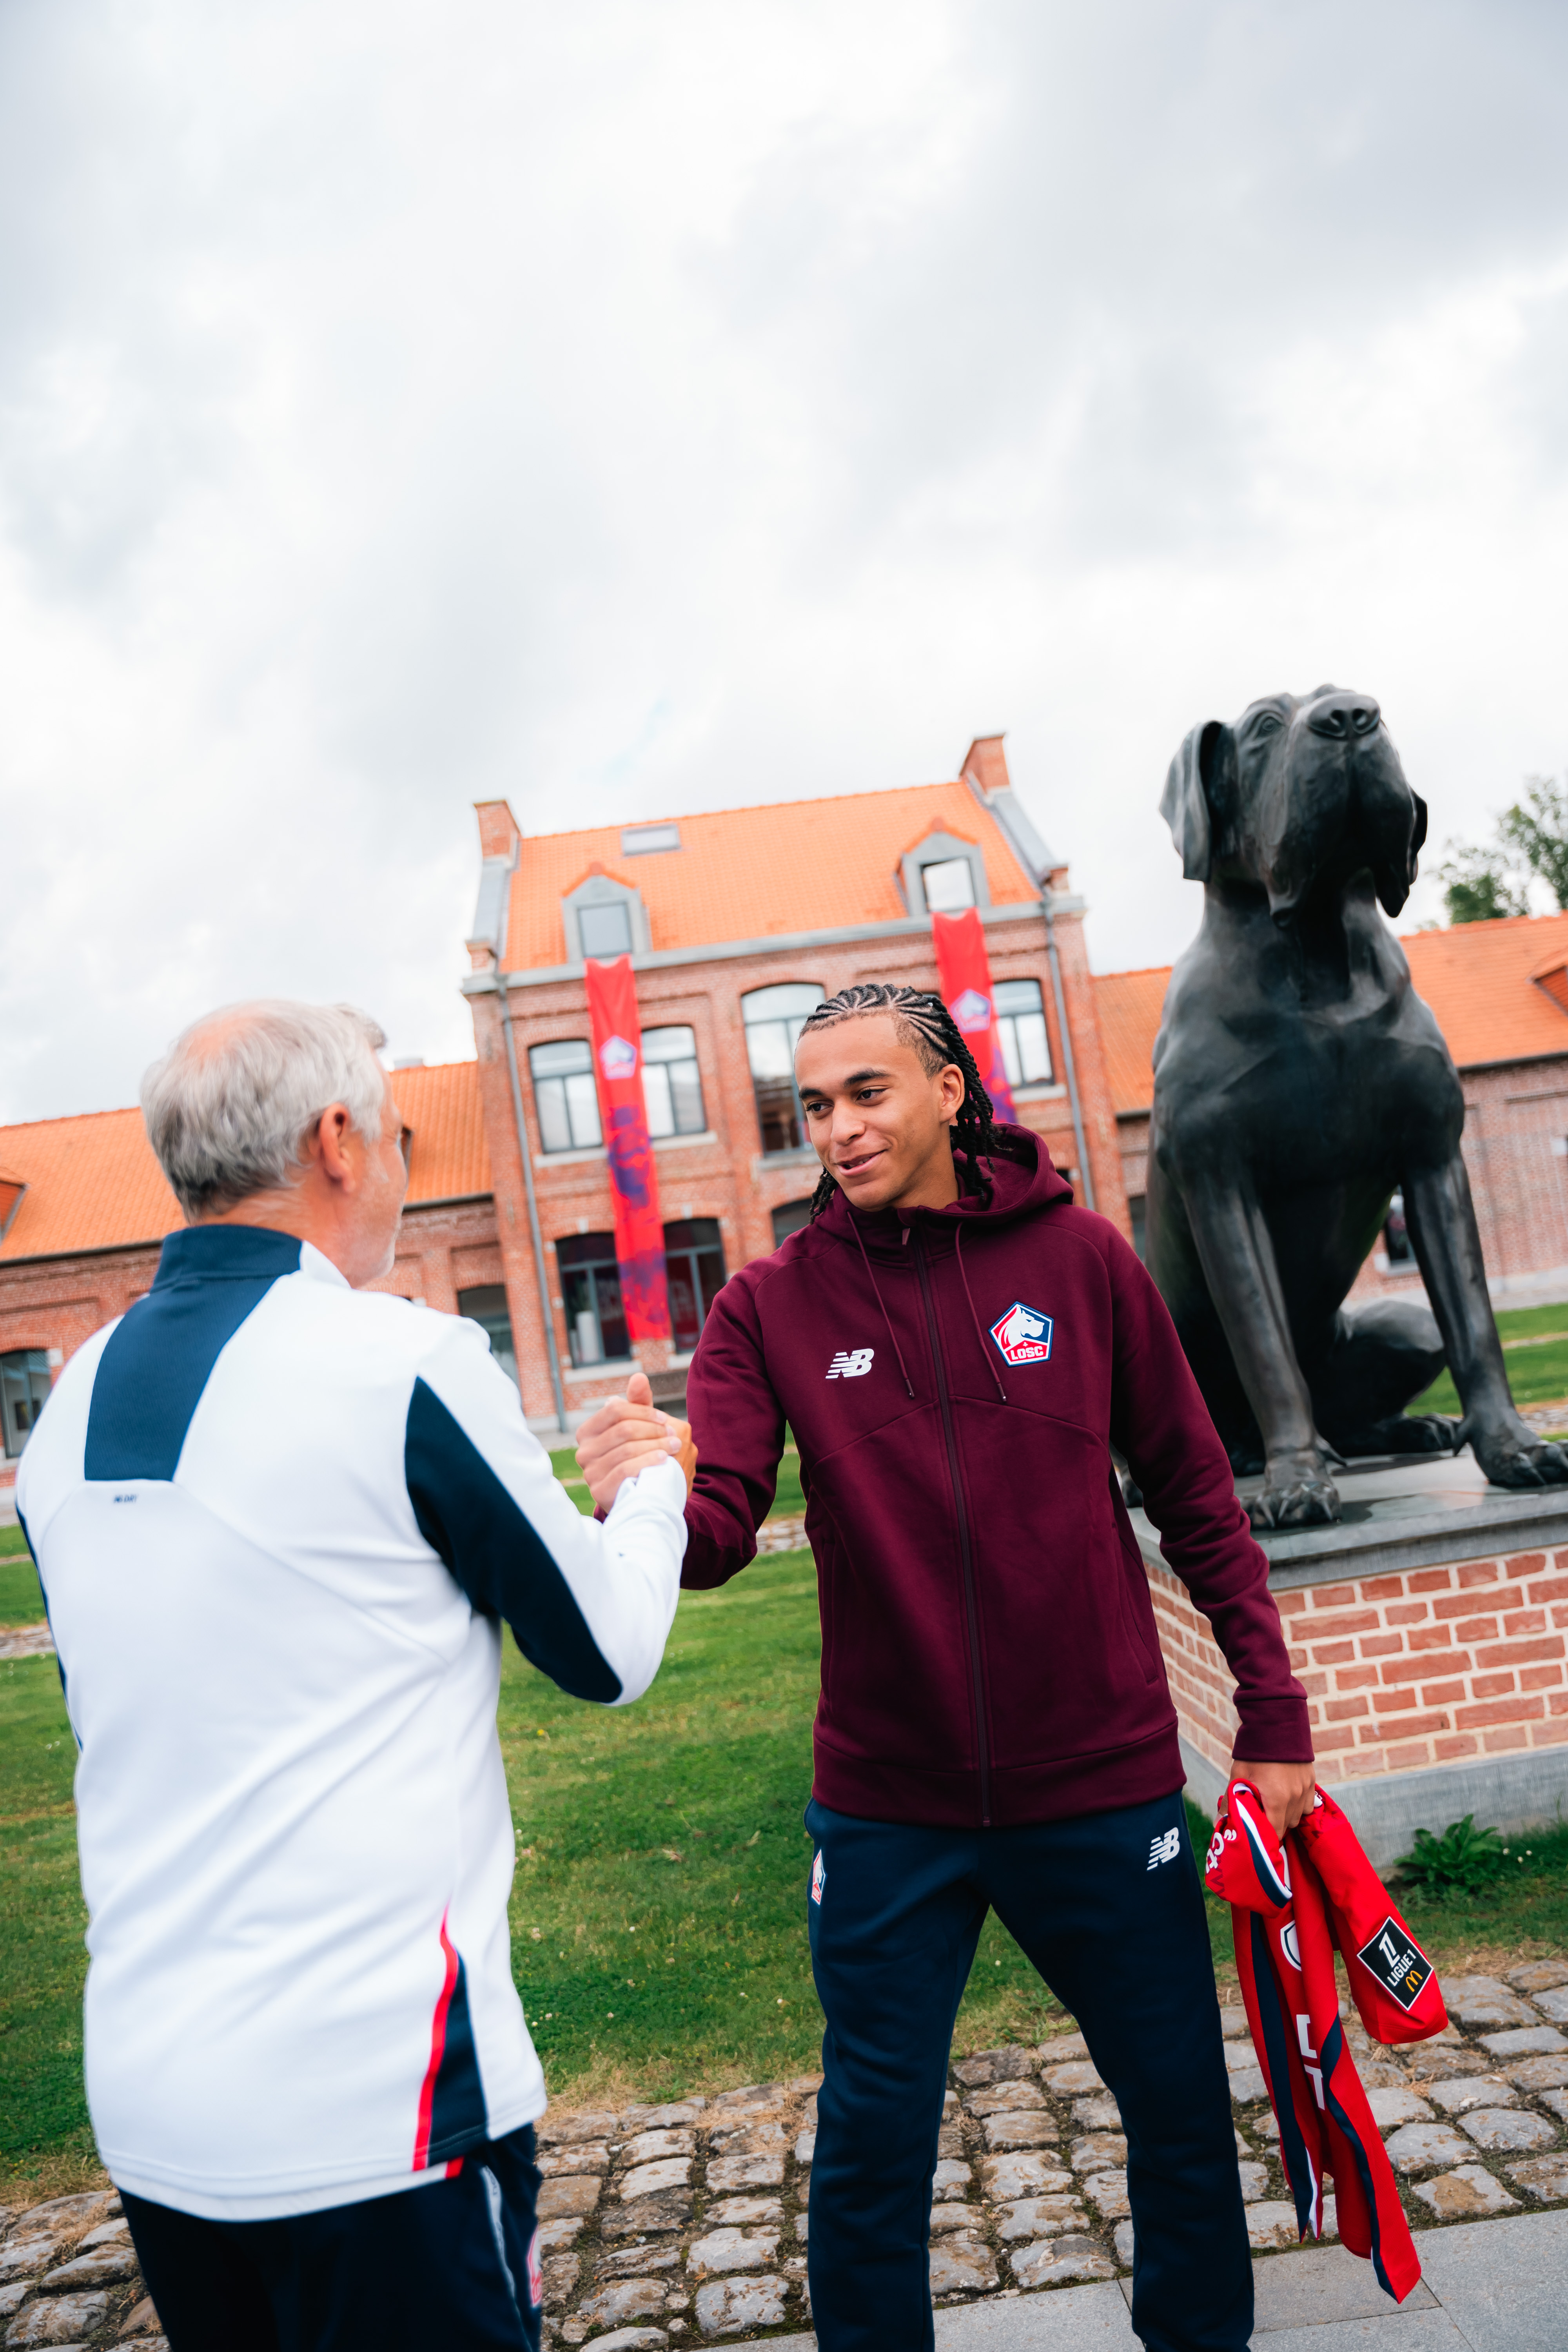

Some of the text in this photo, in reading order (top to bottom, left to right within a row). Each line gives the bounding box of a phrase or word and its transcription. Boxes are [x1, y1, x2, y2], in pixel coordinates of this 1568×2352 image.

[825, 1348, 875, 1379] NB
[1010, 1346, 1044, 1360] LOSC
[1147, 1827, 1180, 1871] NB
[1387, 1949, 1416, 1987] LIGUE 1
